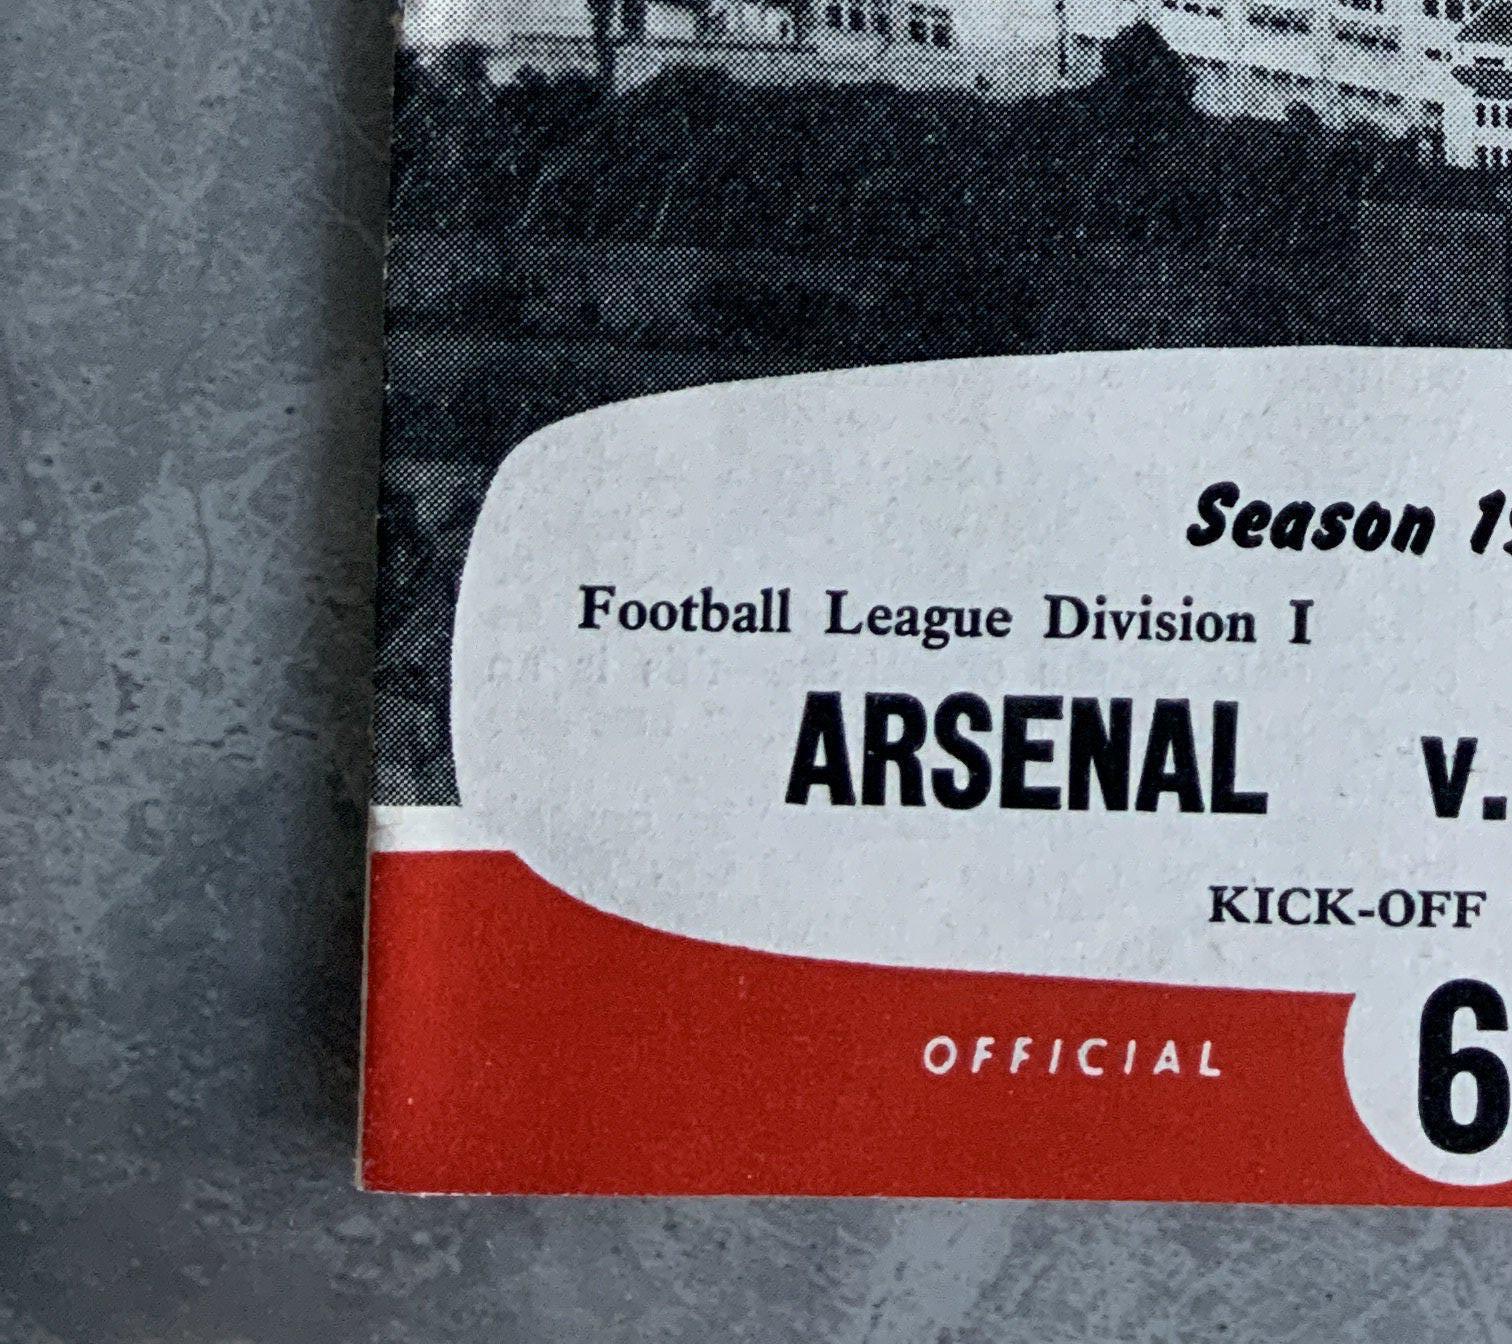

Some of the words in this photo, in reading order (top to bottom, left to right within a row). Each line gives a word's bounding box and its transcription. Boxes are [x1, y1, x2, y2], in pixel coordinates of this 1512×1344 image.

[1186, 481, 1436, 556] Season
[578, 584, 791, 634] Football
[824, 589, 1013, 650] League
[1043, 594, 1257, 643] Division
[1289, 599, 1314, 645] I
[784, 690, 1269, 815] ARSENAL
[1420, 736, 1508, 821] v.
[1208, 885, 1487, 929] KICK-OFF
[923, 1035, 1221, 1077] OFFICIAL
